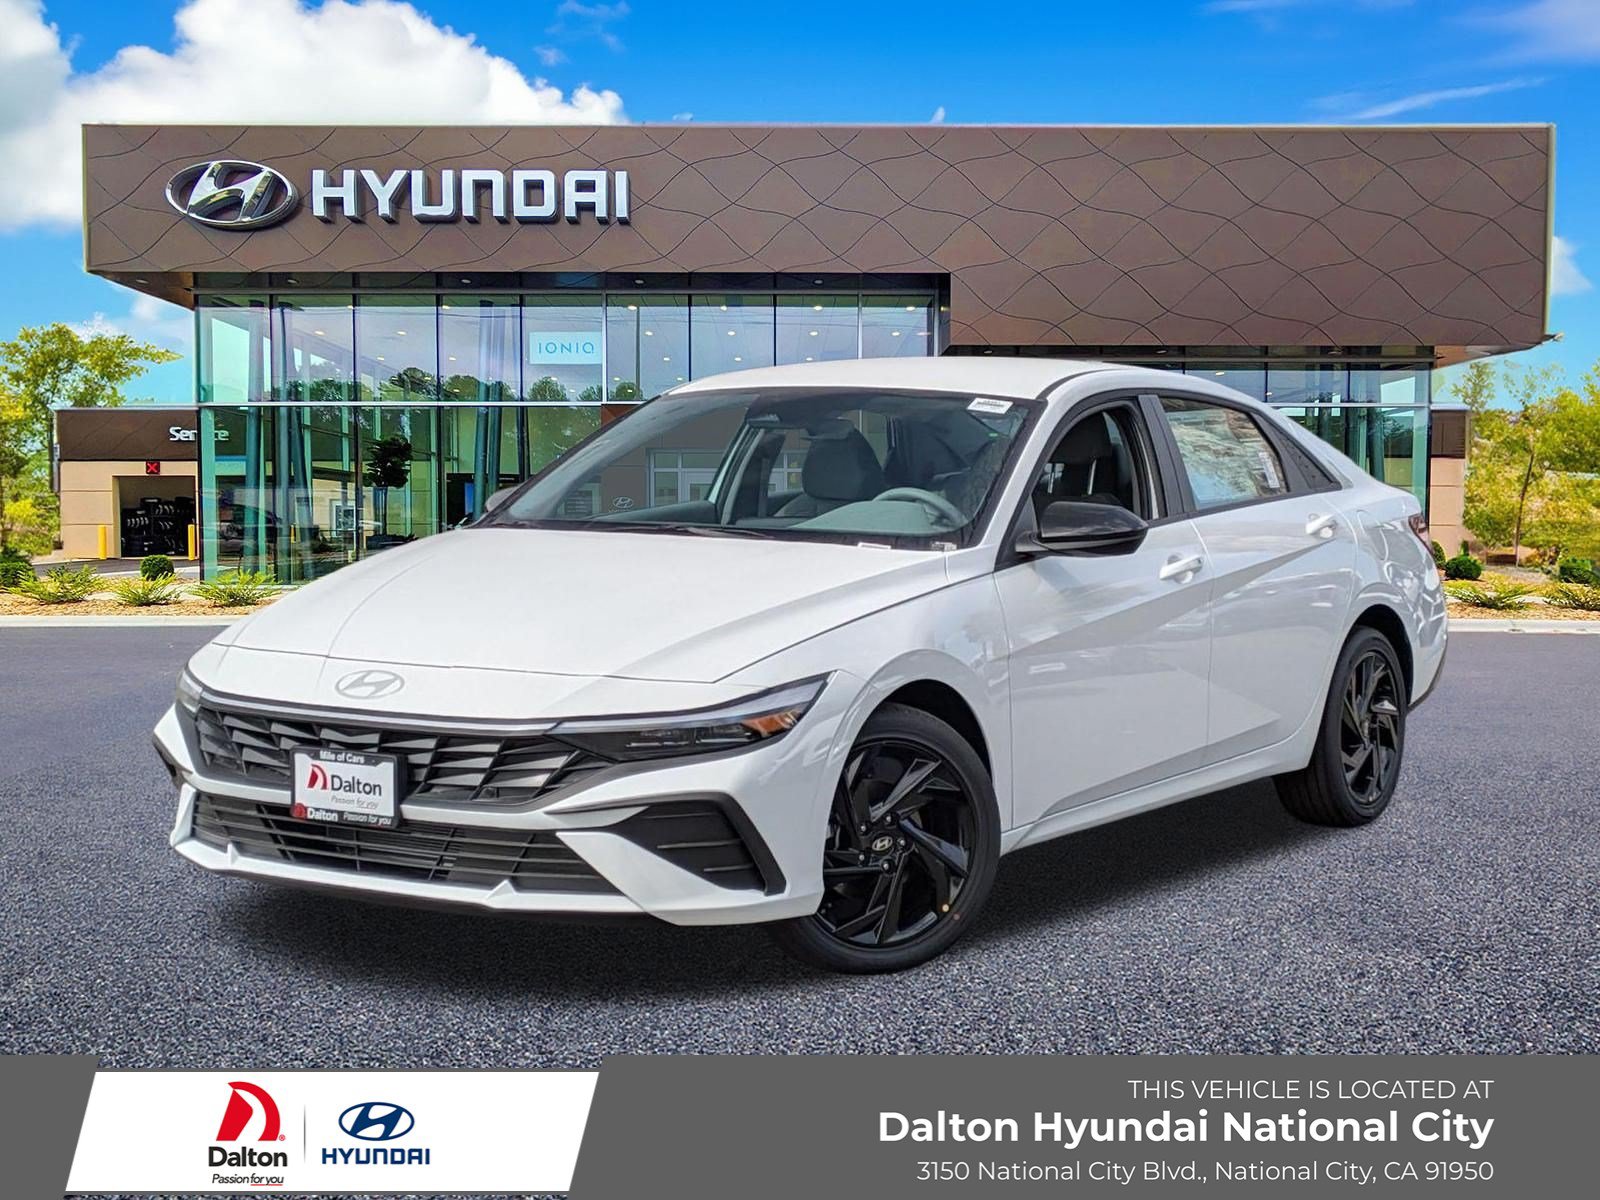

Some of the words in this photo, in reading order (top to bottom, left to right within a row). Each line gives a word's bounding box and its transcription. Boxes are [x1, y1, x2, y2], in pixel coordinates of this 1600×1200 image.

[312, 169, 631, 223] HYUNDAI
[538, 342, 594, 354] IONIQ
[169, 426, 230, 441] Serce
[337, 753, 345, 762] of
[346, 754, 365, 764] Cars
[330, 774, 382, 796] Dalton
[307, 807, 339, 821] Dalton
[343, 812, 368, 823] Passion
[368, 815, 378, 824] for
[378, 817, 392, 826] you
